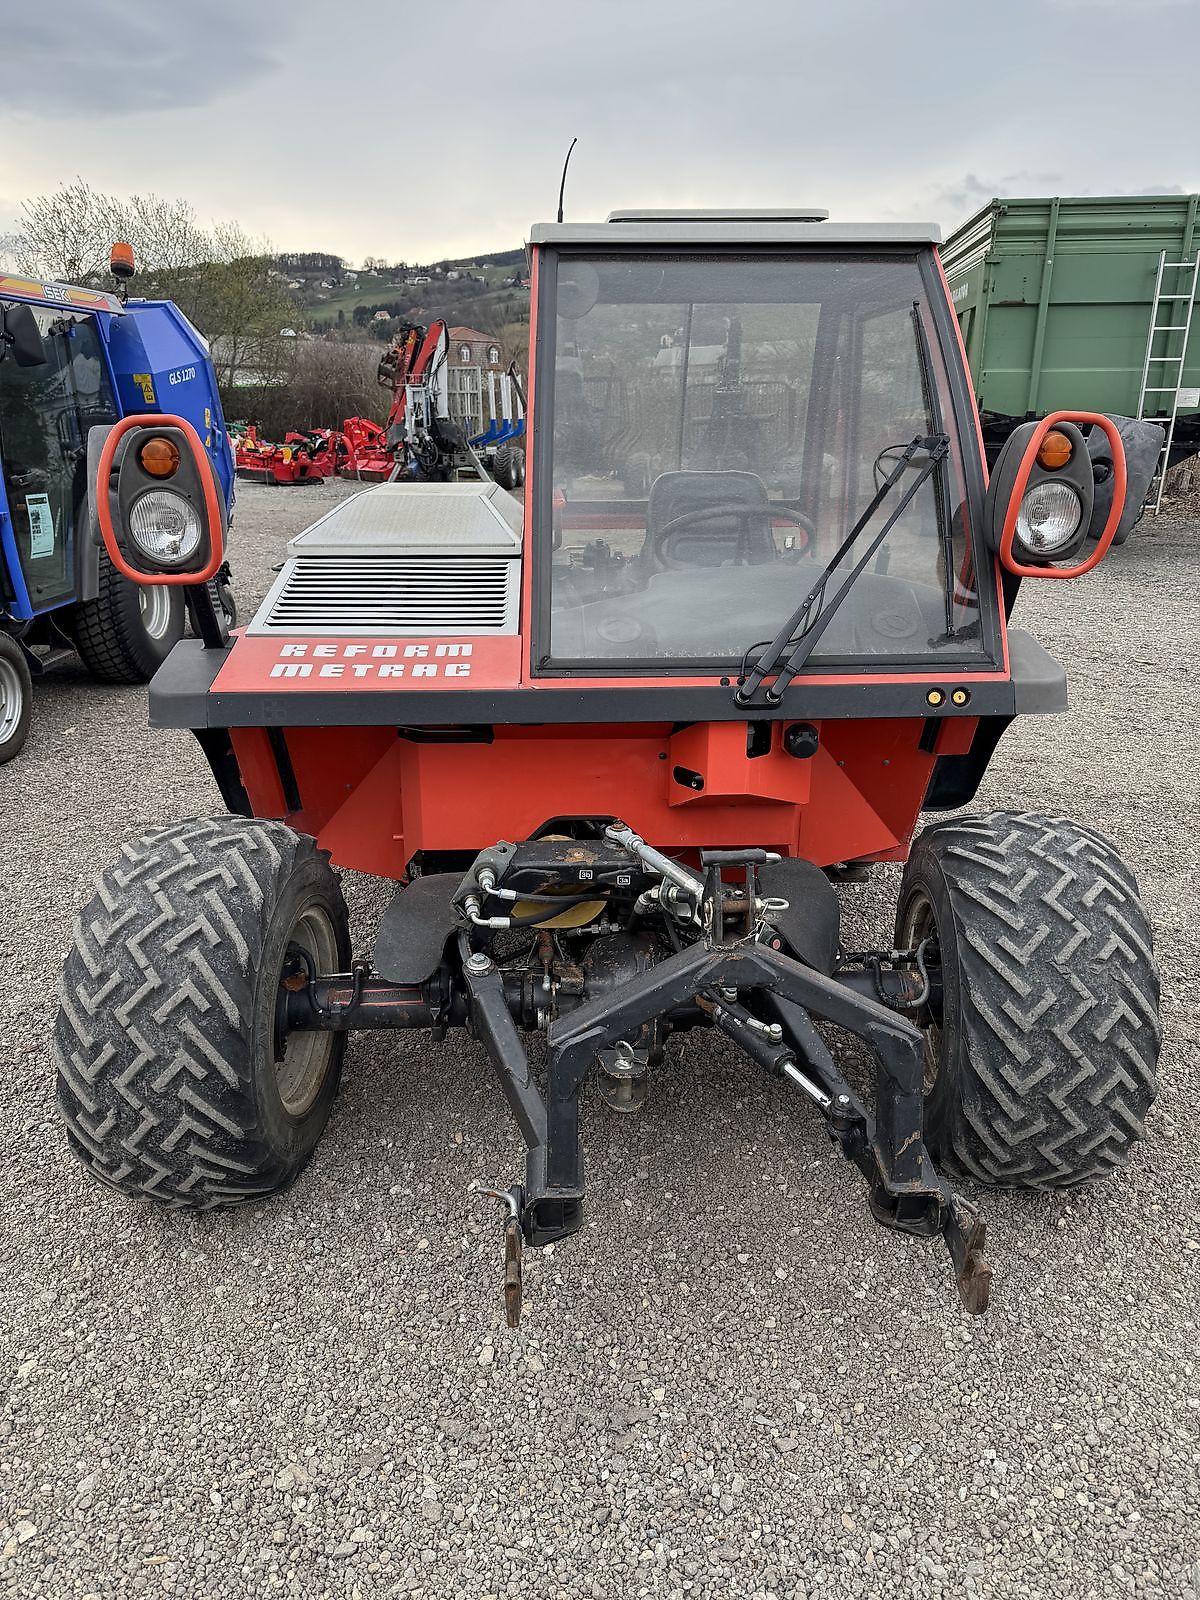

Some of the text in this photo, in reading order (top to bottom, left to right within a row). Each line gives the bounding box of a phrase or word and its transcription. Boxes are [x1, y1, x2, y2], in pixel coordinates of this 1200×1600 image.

[169, 367, 196, 385] GLS 1270
[279, 643, 473, 657] REFORM
[269, 663, 471, 678] METRAC
